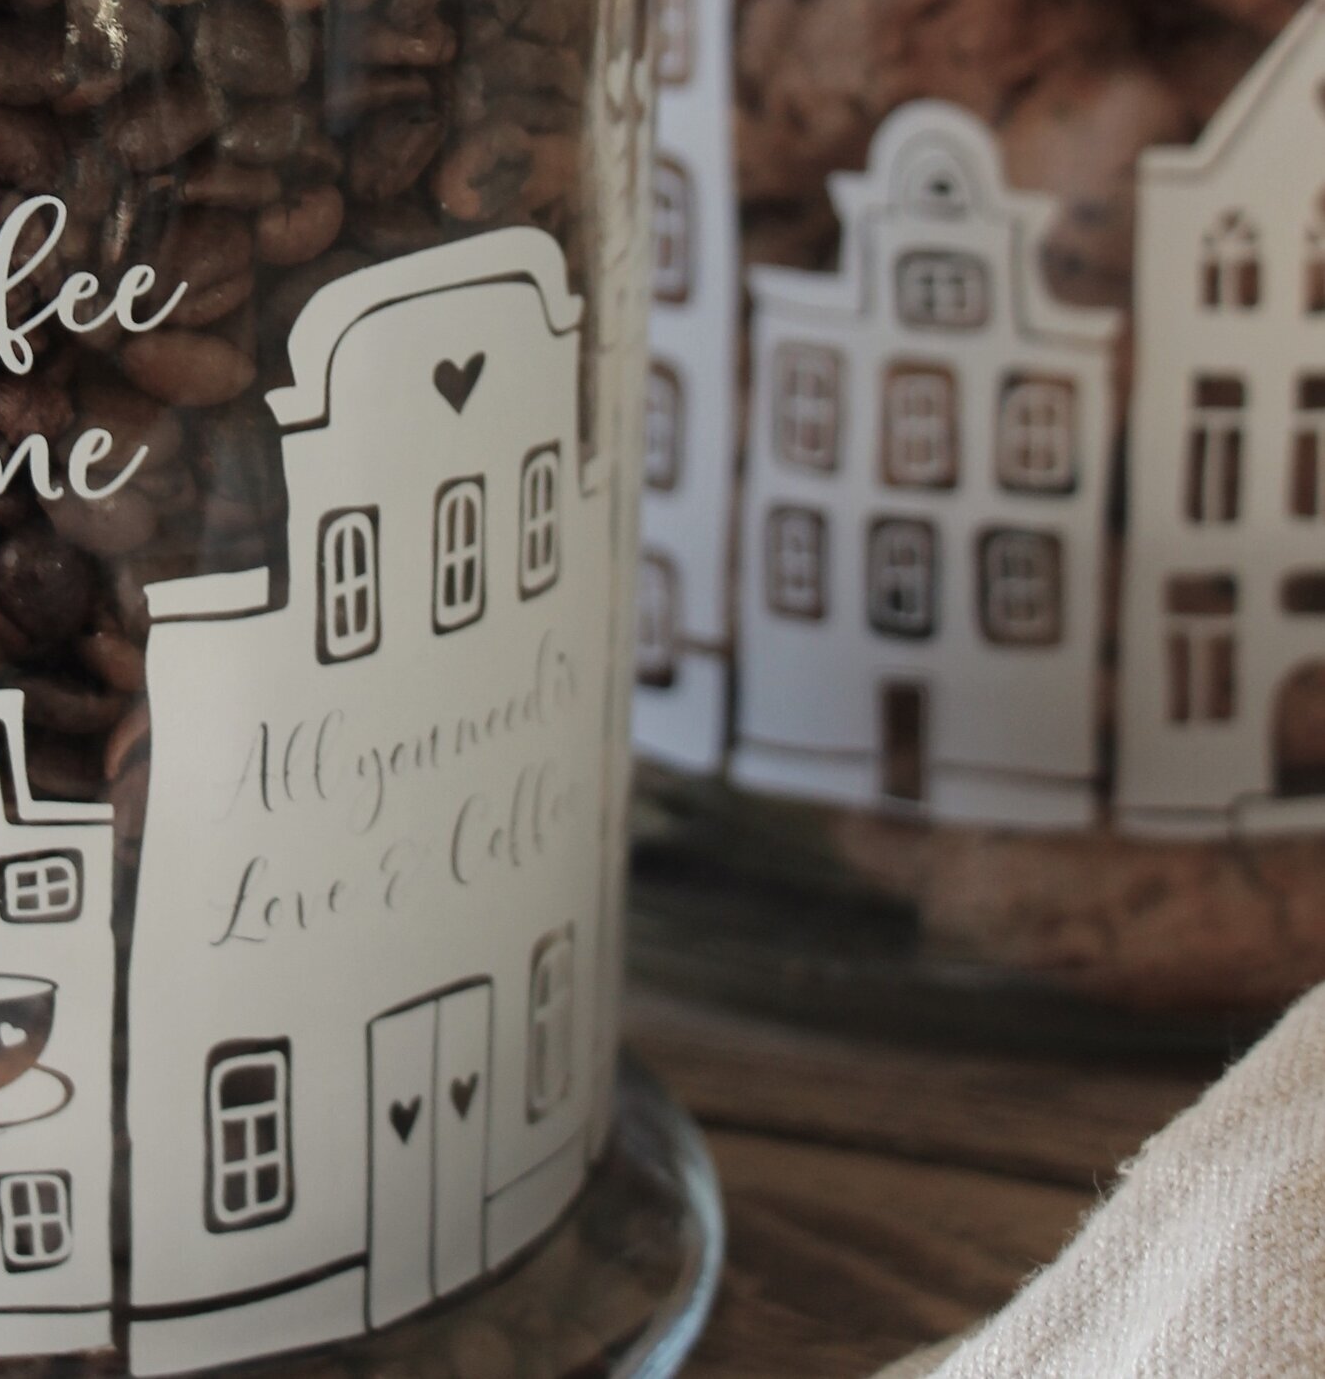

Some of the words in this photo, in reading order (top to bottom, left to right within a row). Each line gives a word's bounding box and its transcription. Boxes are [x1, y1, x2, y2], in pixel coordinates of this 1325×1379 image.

[214, 709, 345, 821] All
[348, 723, 442, 836] you
[208, 854, 355, 947] Love
